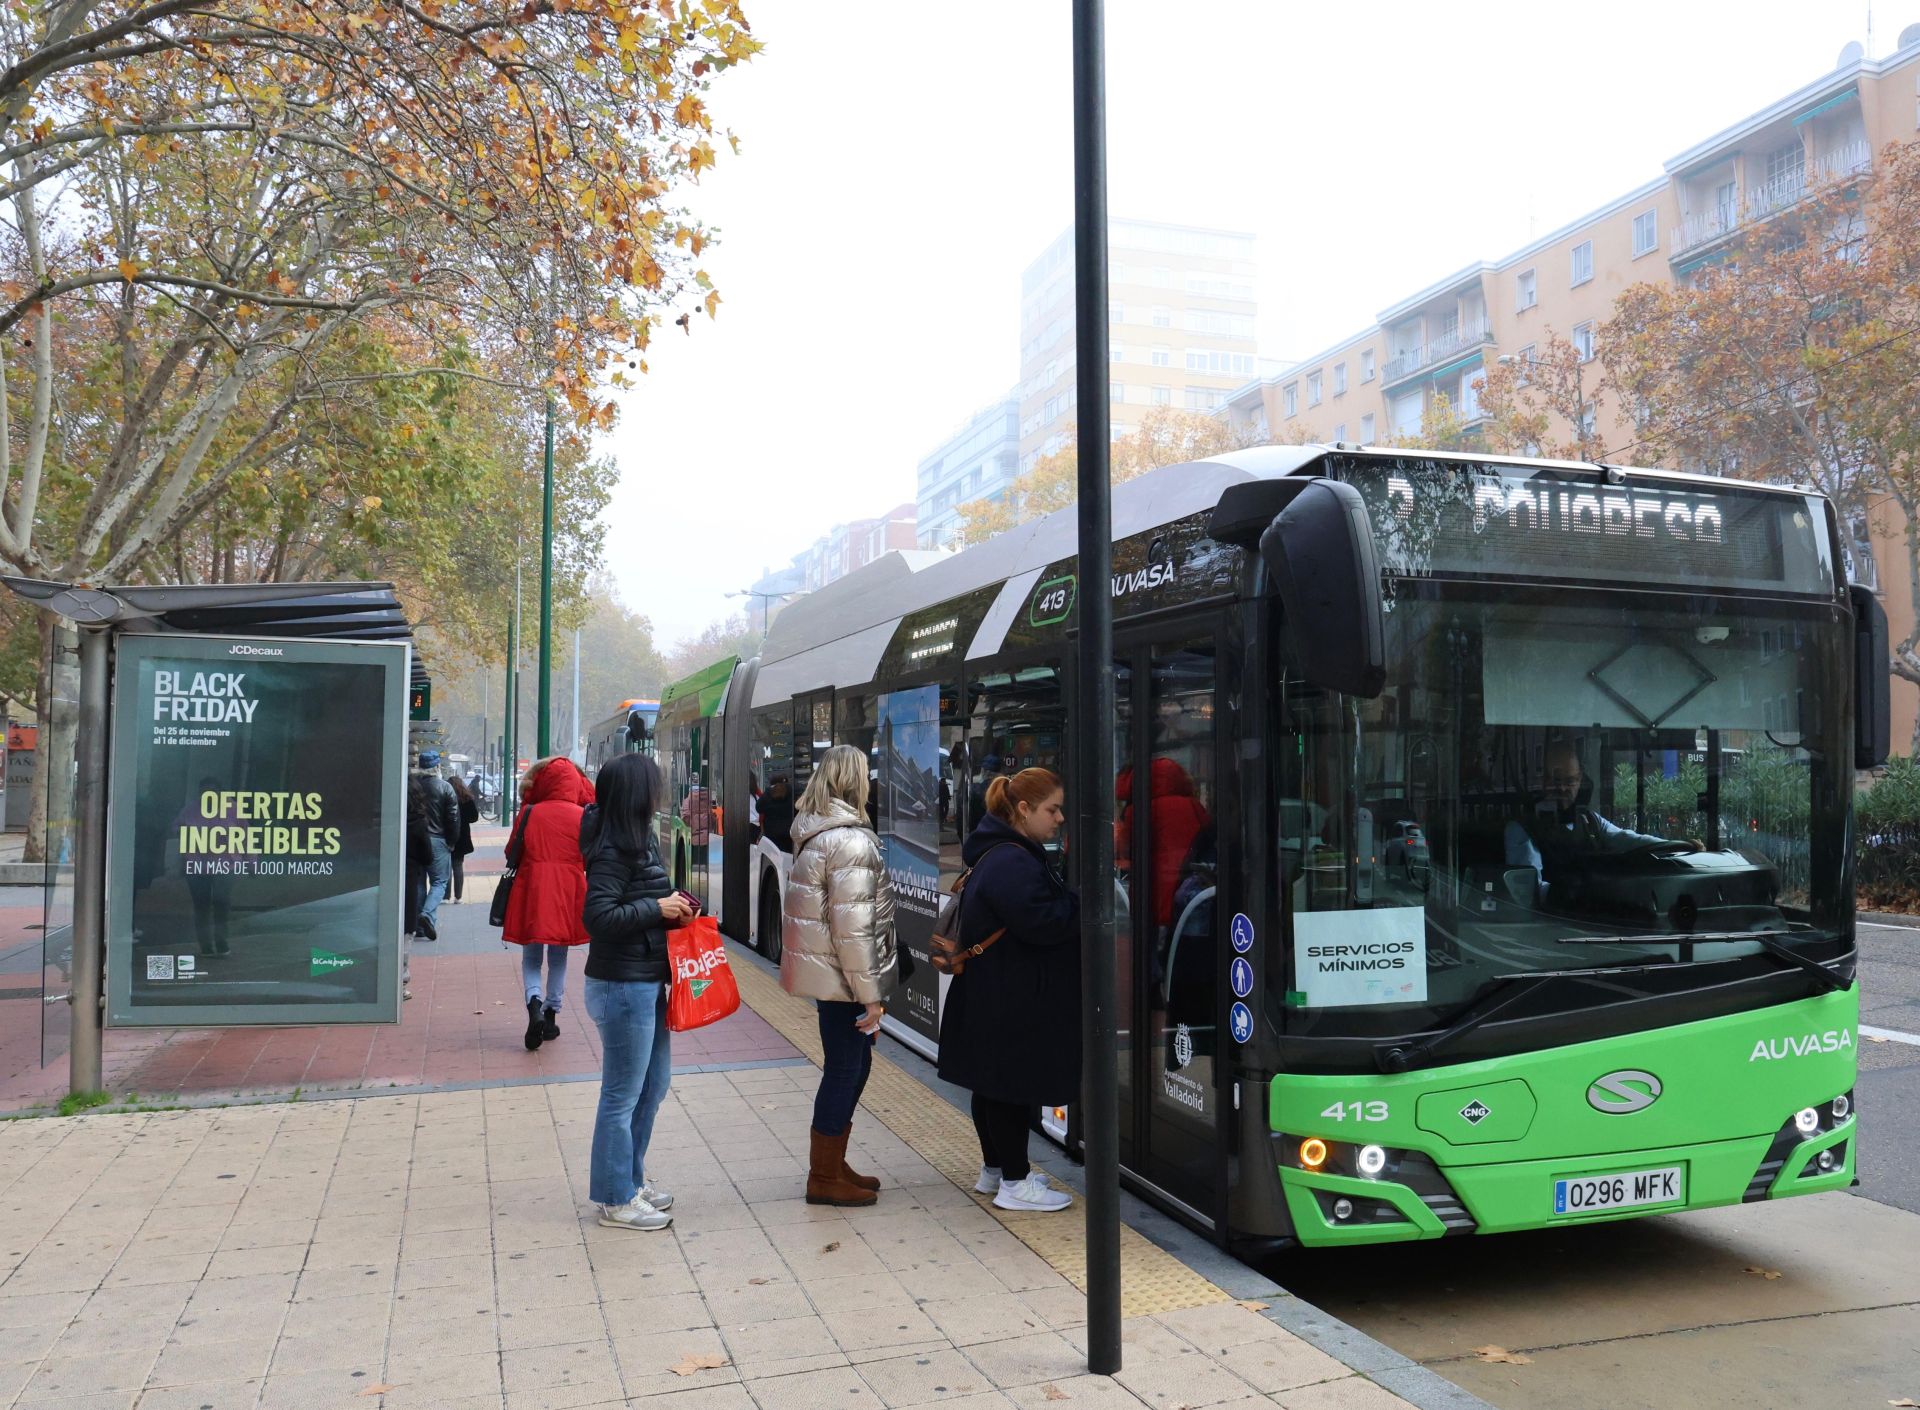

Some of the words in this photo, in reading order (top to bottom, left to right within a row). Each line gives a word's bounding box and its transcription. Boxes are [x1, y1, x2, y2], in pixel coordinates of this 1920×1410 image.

[1040, 590, 1065, 612] 413
[229, 645, 283, 656] JCDecaux
[155, 670, 246, 698] BLACK
[154, 697, 259, 723] FRIDAY
[153, 727, 166, 735] Del
[167, 727, 178, 736] 25
[179, 727, 189, 736] de
[190, 728, 230, 737] noviembre
[153, 736, 161, 745] al
[162, 736, 166, 745] 1
[167, 736, 177, 745] de
[178, 737, 217, 746] diciembre
[201, 791, 322, 820] OFERTAS
[179, 820, 341, 855] INCREÍBLES
[186, 861, 202, 875] EN
[206, 858, 230, 875] MÁS
[234, 861, 249, 875] DE
[253, 861, 284, 875] 1.000
[287, 862, 333, 876] MARCAS
[1307, 942, 1415, 957] SERVICIOS
[1318, 958, 1405, 973] MÍNIMOS
[1749, 1028, 1852, 1062] AUVASA
[1164, 1067, 1197, 1089] Ayuntamiento
[1196, 1081, 1203, 1092] de
[1164, 1080, 1204, 1111] Valladolid
[1320, 1101, 1389, 1123] 413
[1464, 1107, 1486, 1117] CNG
[1570, 1179, 1624, 1208] 0296
[1634, 1172, 1674, 1200] MFK
